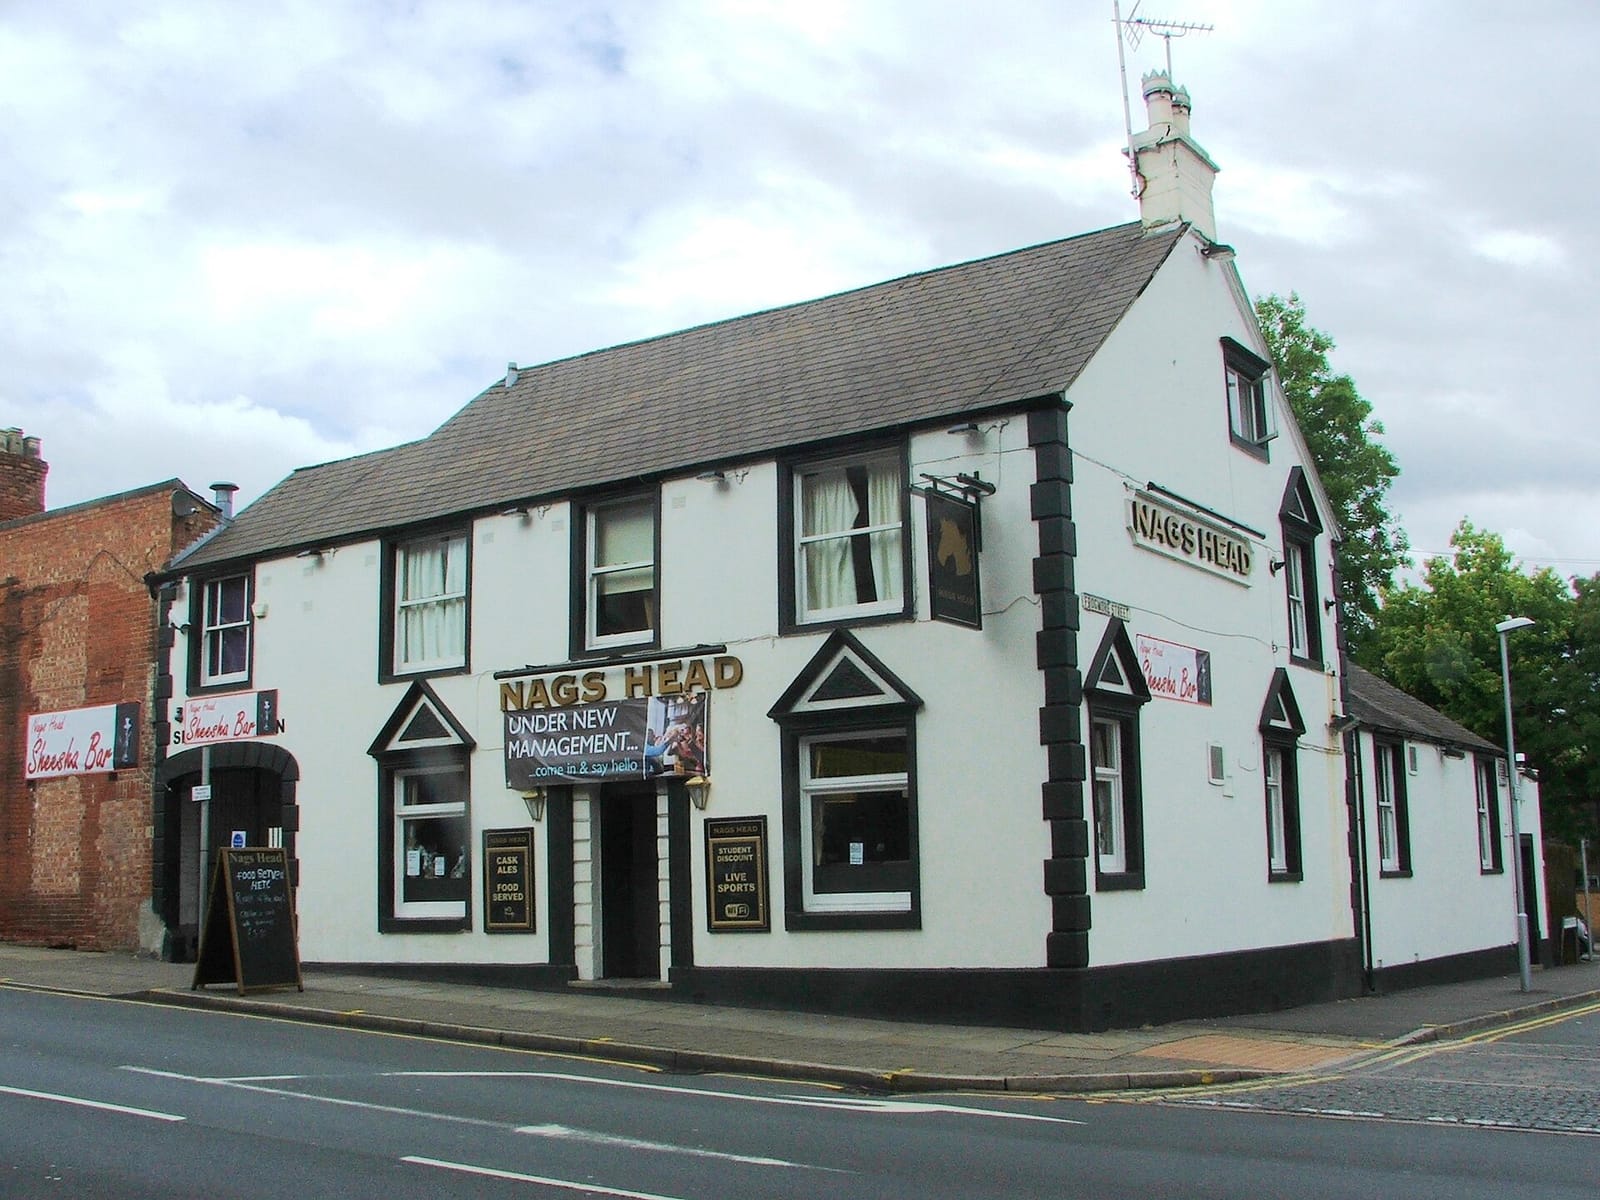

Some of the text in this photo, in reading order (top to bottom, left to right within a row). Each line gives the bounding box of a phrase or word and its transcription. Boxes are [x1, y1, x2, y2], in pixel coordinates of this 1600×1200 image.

[1131, 500, 1251, 576] NAGS HEAD
[500, 656, 744, 711] NAGS HEAD
[1180, 667, 1196, 698] Bar
[186, 711, 256, 740] Sheesha Bar
[508, 708, 617, 734] UNDER NEW
[508, 731, 639, 759] MANAGEMENT...
[28, 731, 112, 774] Sheesha Bar
[529, 758, 638, 777] ...come in & say hello
[718, 846, 752, 855] STUDENT
[229, 853, 282, 865] Nags Head
[496, 856, 519, 865] CASK
[717, 854, 753, 863] DISCOUNT
[236, 869, 256, 880] FOOD
[496, 866, 518, 874] ALES
[725, 873, 747, 882] LIVE
[497, 883, 519, 892] FOOD
[718, 883, 755, 893] SPORTS
[492, 893, 524, 902] SERVED
